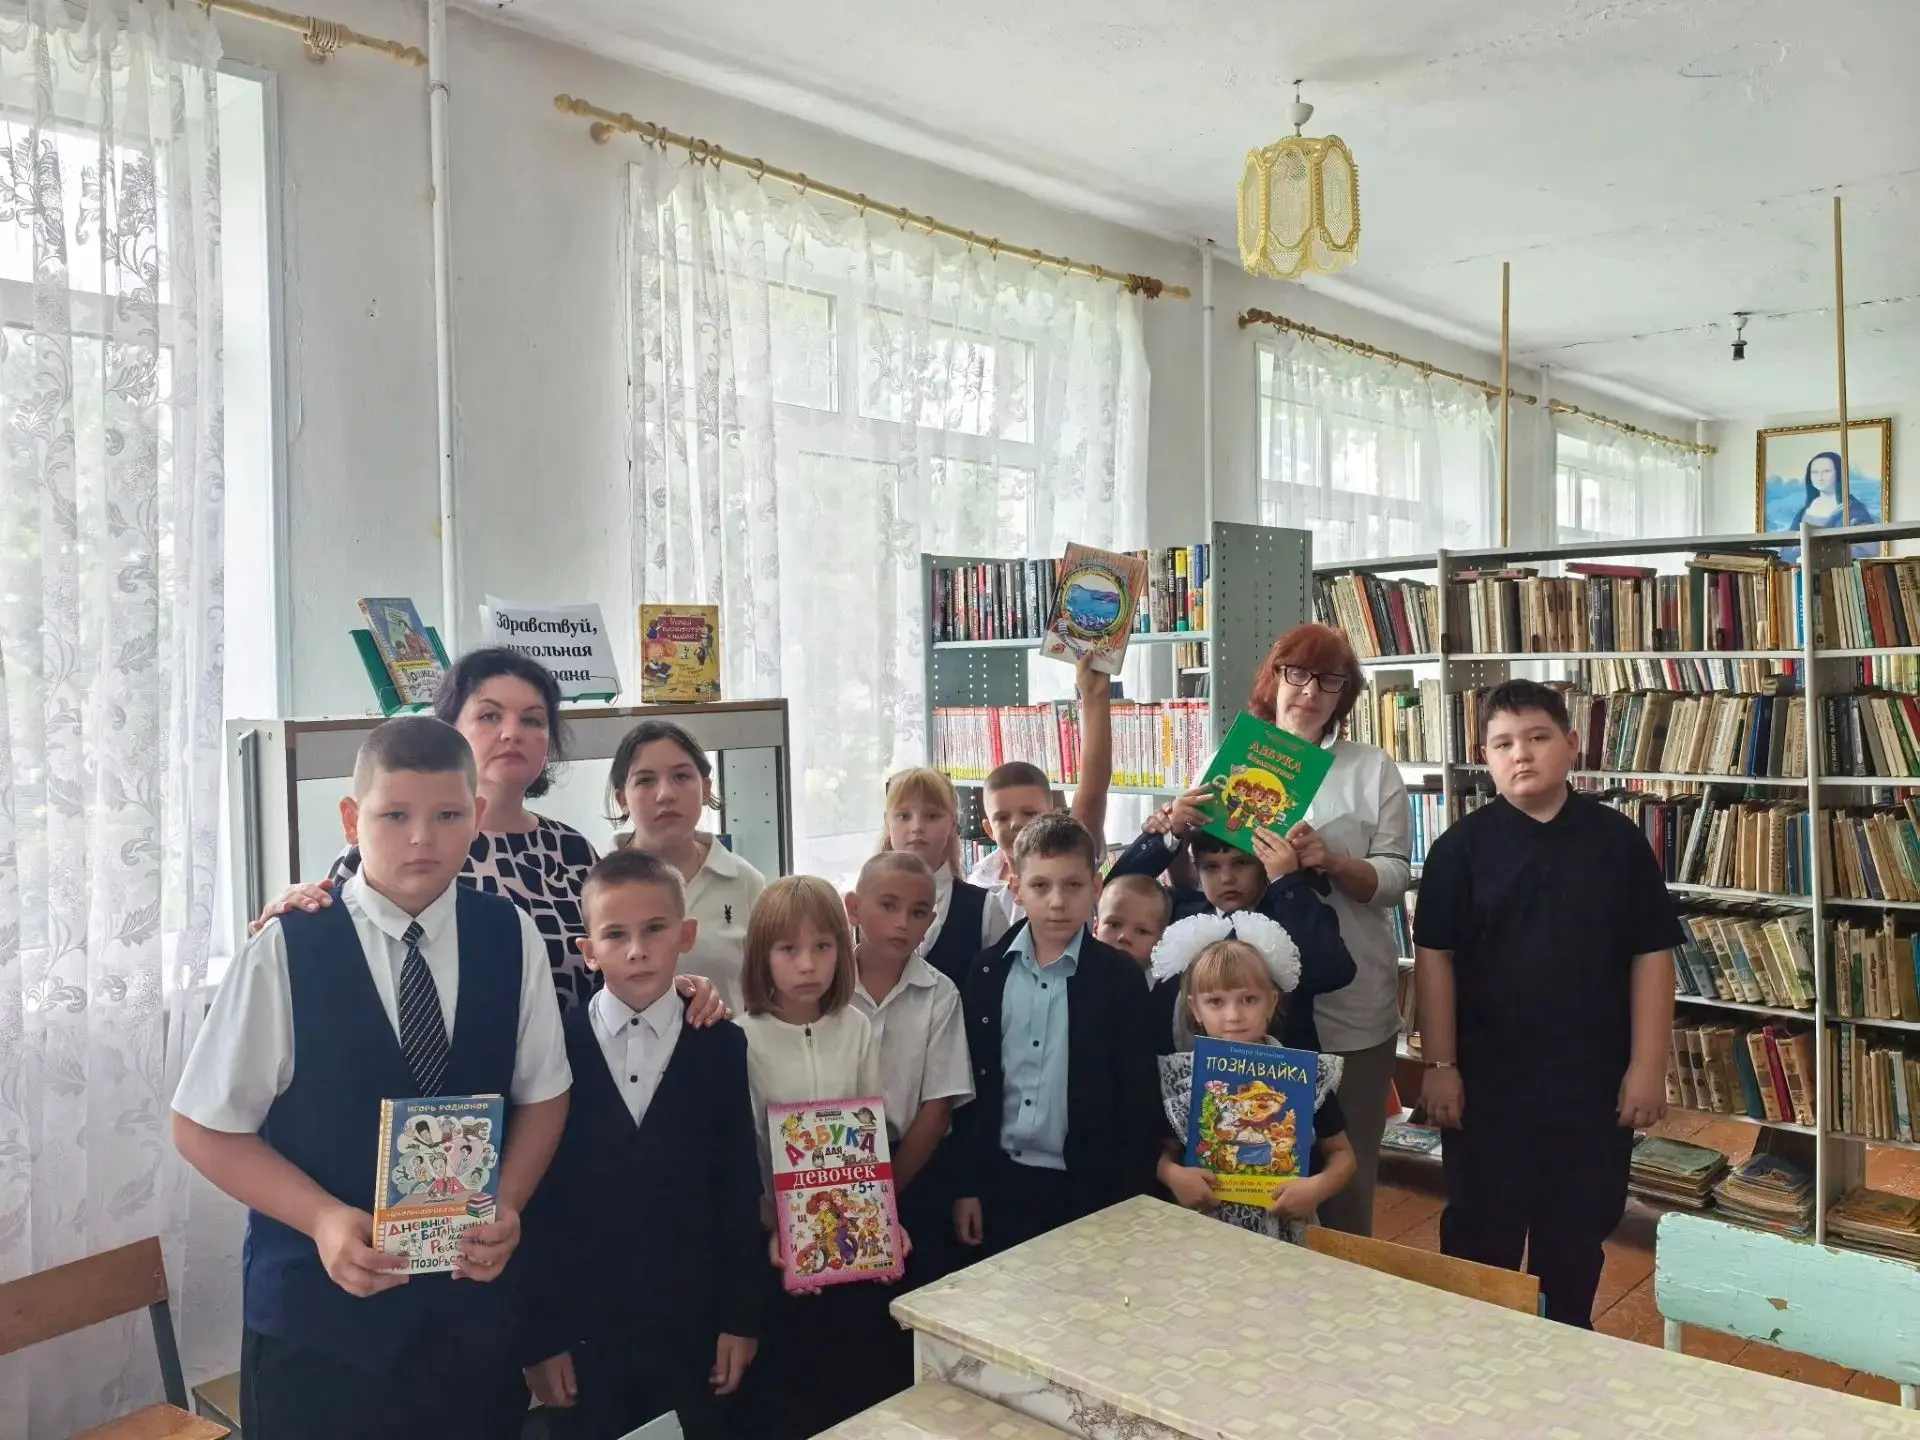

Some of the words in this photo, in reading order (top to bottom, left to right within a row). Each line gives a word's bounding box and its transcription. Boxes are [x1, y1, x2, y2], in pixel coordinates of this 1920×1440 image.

[496, 611, 598, 638] Здравствуй,
[1206, 1056, 1308, 1084] ПОЗНАВАЙКА
[785, 1123, 876, 1168] АЗБУКА
[858, 1181, 875, 1194] 5+
